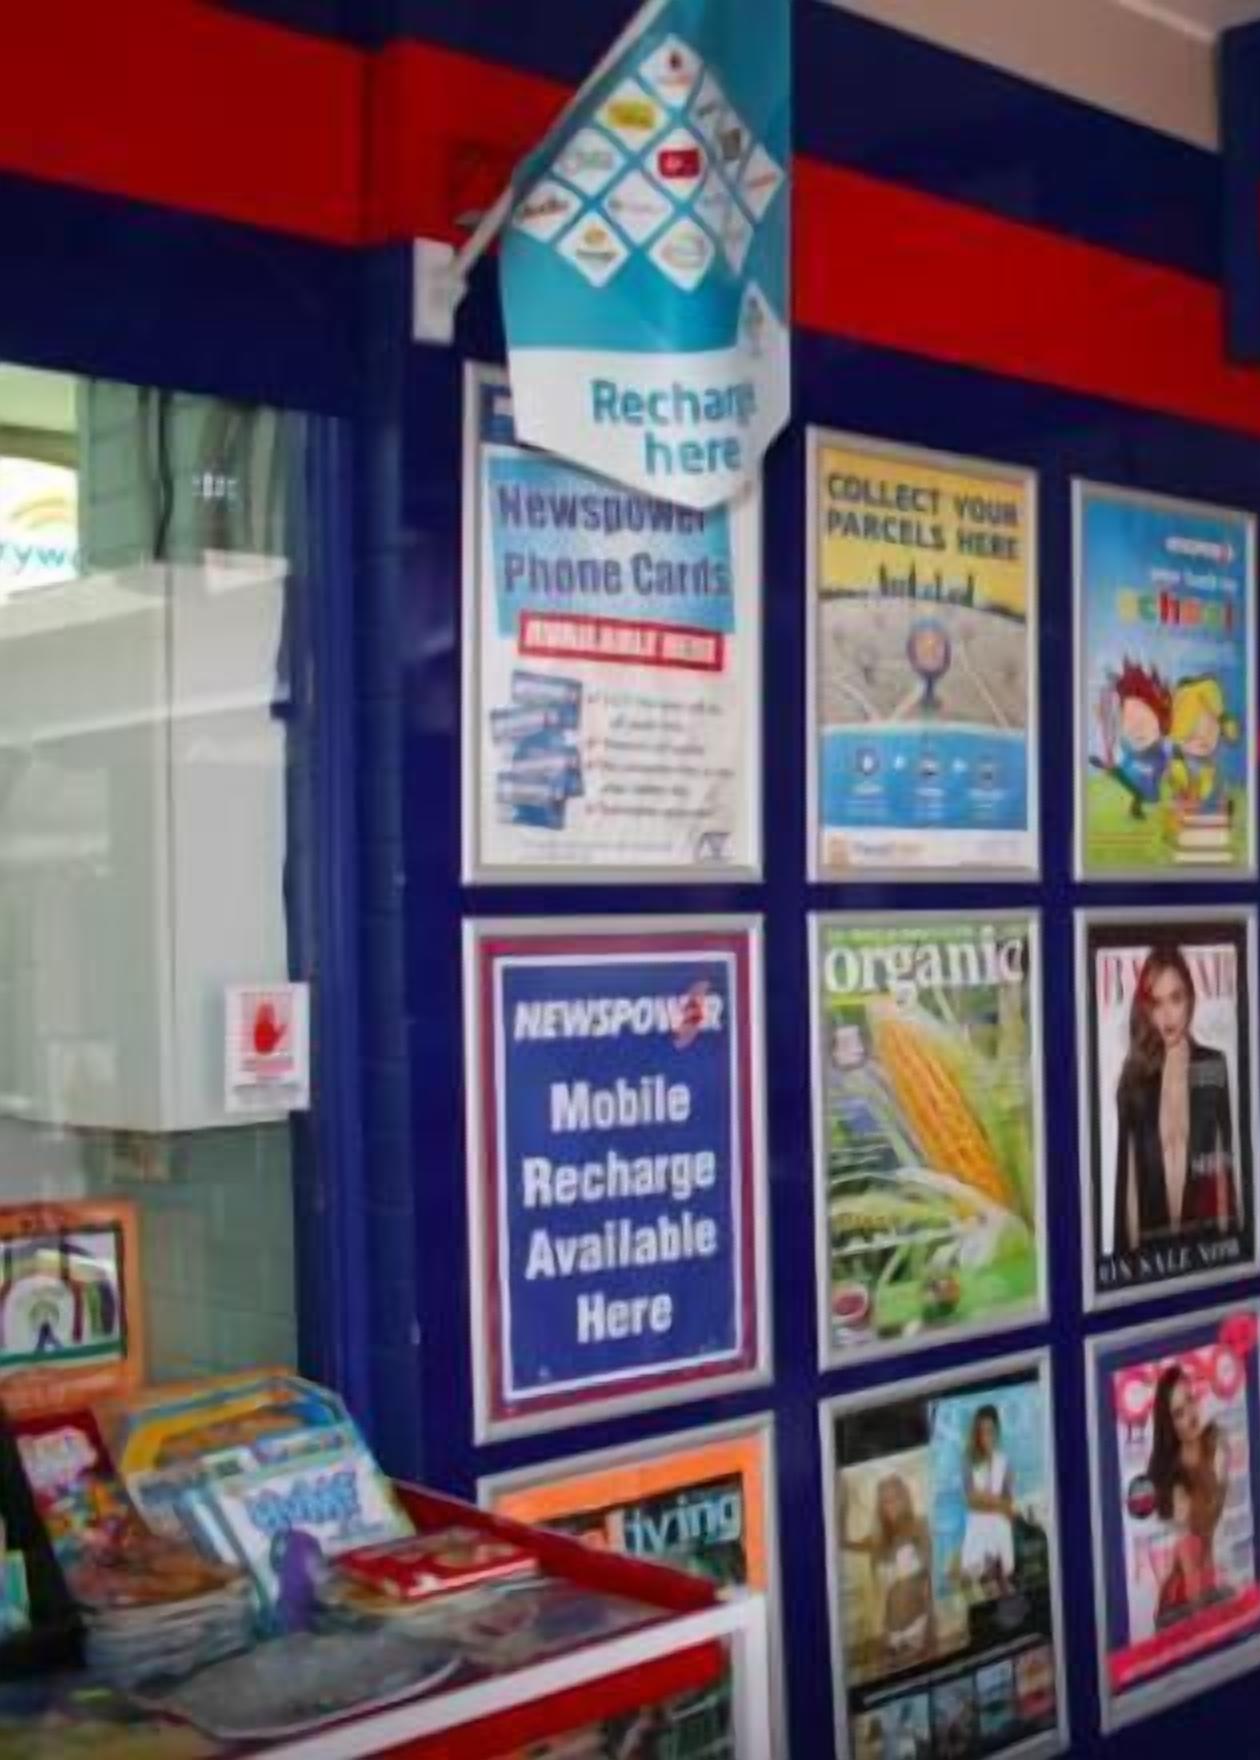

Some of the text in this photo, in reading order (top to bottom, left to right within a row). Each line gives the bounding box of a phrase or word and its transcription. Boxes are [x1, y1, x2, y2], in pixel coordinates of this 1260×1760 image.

[645, 432, 742, 475] here
[828, 473, 1018, 526] COLLECT YOUR
[828, 510, 1019, 560] PARCELS HERE
[504, 551, 733, 596] Phone Cards
[825, 926, 1024, 1007] organic
[550, 1074, 690, 1132] Mobile
[522, 1149, 716, 1208] Recharge
[525, 1216, 718, 1280] Available
[577, 1292, 673, 1344] Here
